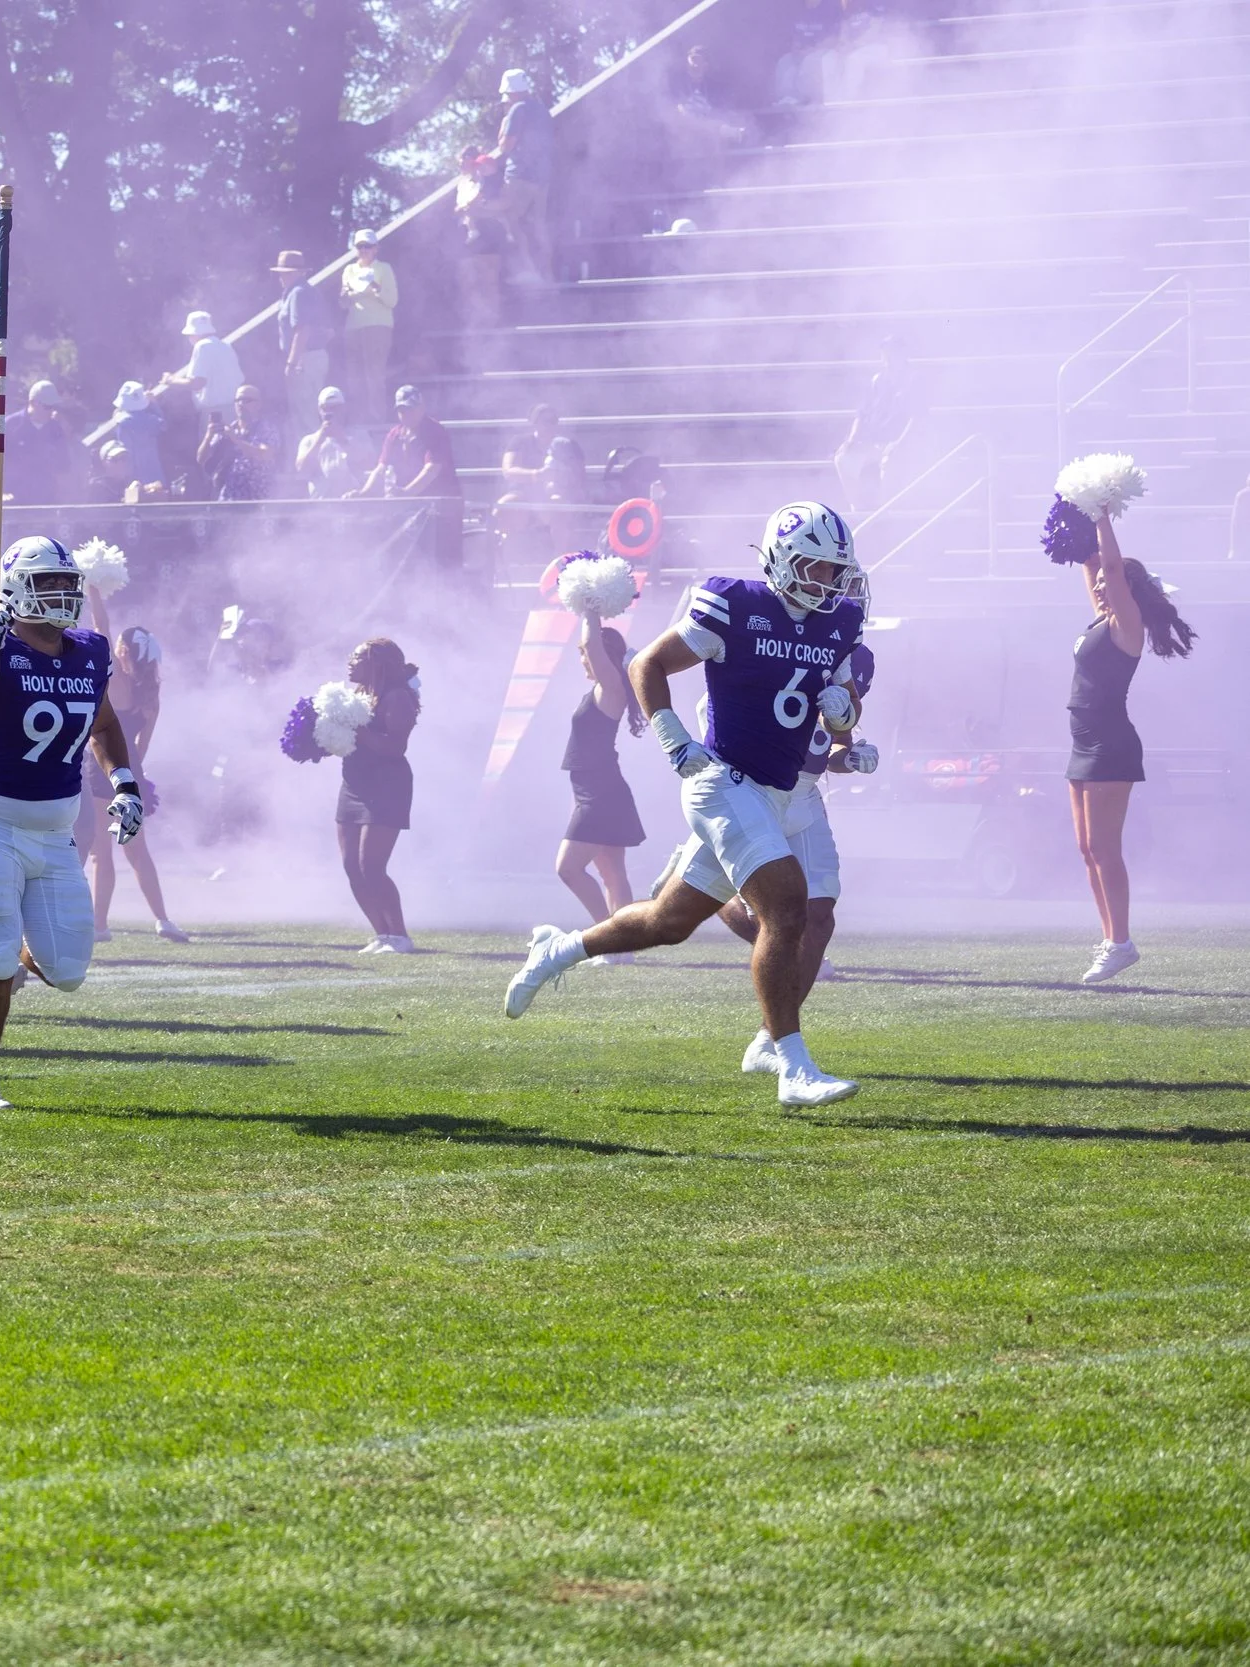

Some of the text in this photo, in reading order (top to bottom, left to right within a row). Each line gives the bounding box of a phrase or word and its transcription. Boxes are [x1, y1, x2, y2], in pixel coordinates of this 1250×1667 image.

[755, 637, 836, 666] HOLY CROSS
[21, 674, 95, 695] HOLY CROSS
[773, 667, 809, 729] 6
[22, 700, 96, 764] 97
